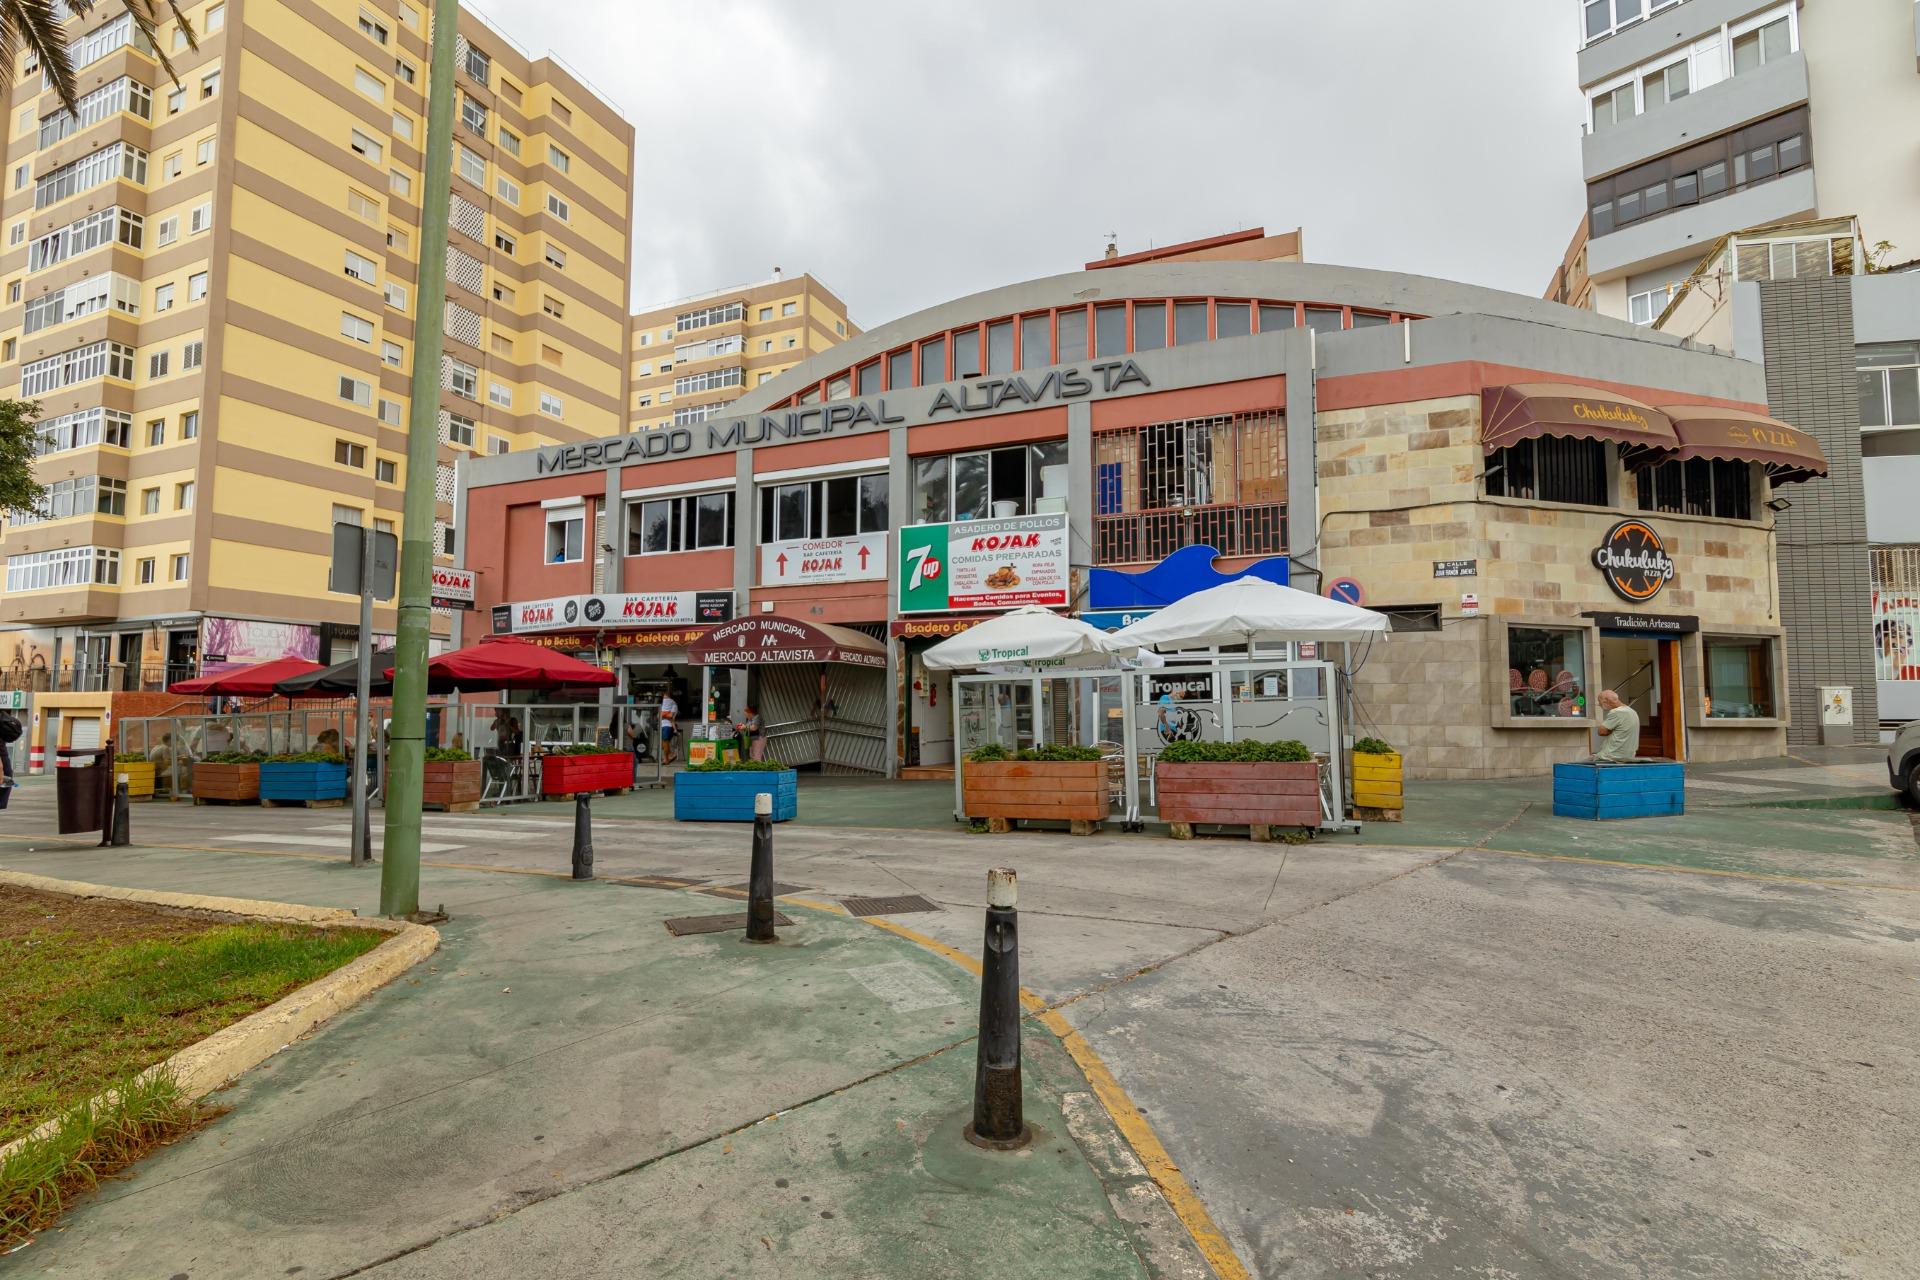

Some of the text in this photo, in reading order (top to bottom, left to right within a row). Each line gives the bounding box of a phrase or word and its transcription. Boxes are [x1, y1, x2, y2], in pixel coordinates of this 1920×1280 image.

[537, 359, 1151, 474] MERCADO MUNICIPAL ALTAVISTA
[1573, 403, 1648, 431] Chukuluky
[955, 518, 1060, 535] ASADERO DE POLLOS
[802, 540, 842, 550] COMEDOR
[971, 533, 1041, 552] KOJAK
[951, 549, 1062, 564] COMIDAS PREPARADAS
[1597, 547, 1673, 579] Chukuluky
[801, 557, 842, 573] KOJAK
[521, 607, 554, 625] KOJAK
[622, 601, 678, 618] KOJAK
[904, 622, 950, 633] Asadero
[953, 621, 968, 631] de
[1614, 615, 1681, 629] Tradición Artesana
[616, 634, 631, 644] Bar
[713, 620, 806, 642] MERCADO MUNICIPAL
[544, 636, 552, 646] lo
[554, 635, 580, 646] Bestia
[704, 649, 815, 663] MERCADO ALTAVISTA
[839, 652, 886, 666] MERCADO ALTAVISTA
[992, 645, 1029, 660] Tropical
[1146, 677, 1211, 693] Tropical
